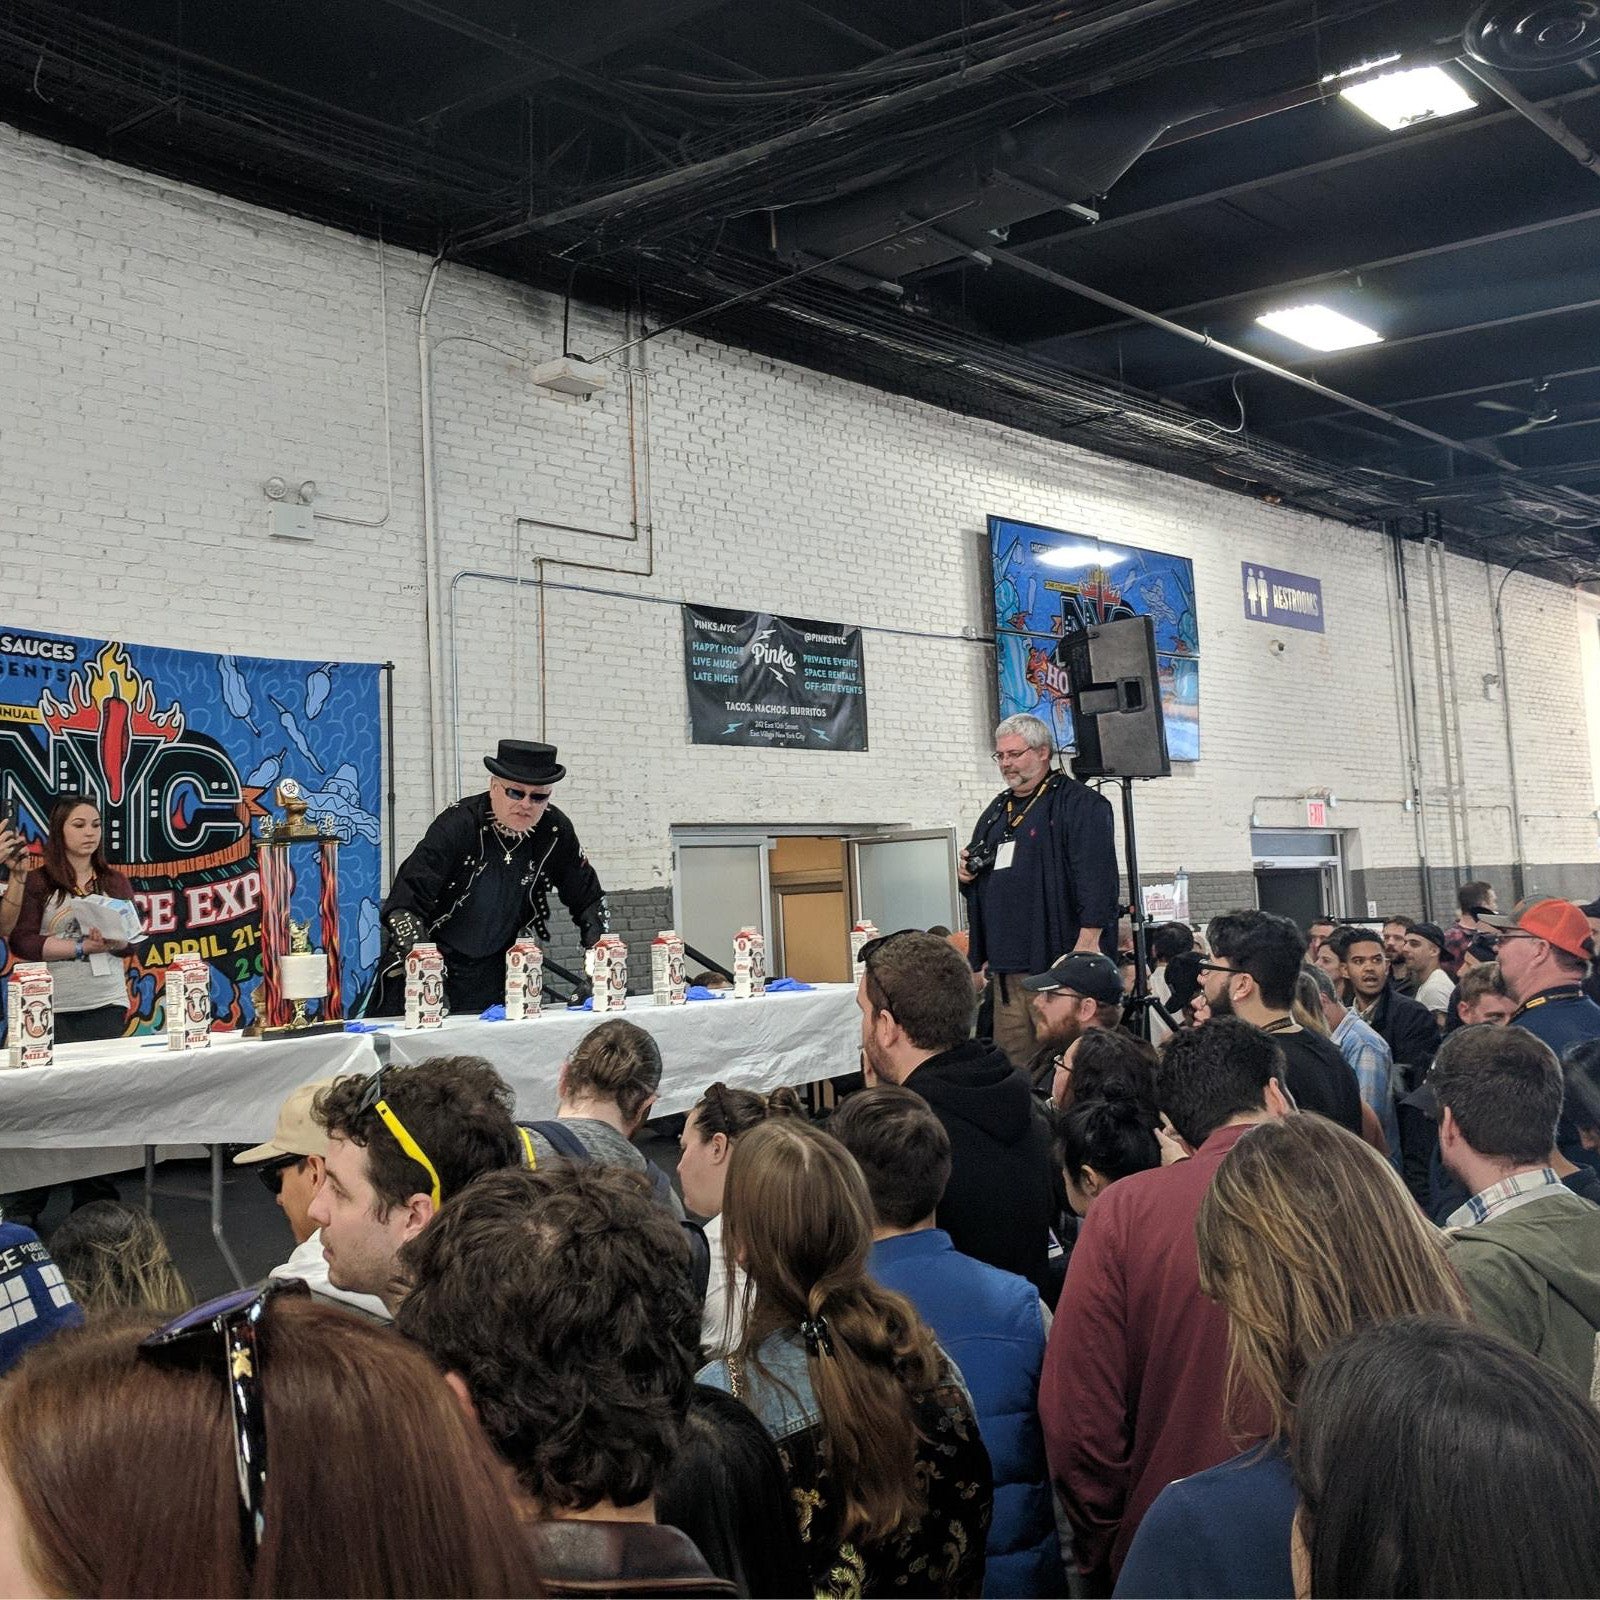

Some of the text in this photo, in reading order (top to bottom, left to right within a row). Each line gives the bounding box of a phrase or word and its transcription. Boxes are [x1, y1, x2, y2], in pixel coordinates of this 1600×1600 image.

[1273, 584, 1318, 616] RESTROOMS
[694, 620, 737, 633] PINKS.NYC
[804, 632, 847, 645] @PINKSNYC
[0, 636, 75, 661] SAUCES
[692, 641, 719, 653] HAPPY
[692, 656, 738, 669] LIVE MUSIC
[751, 642, 797, 675] Pinks
[803, 654, 858, 668] PRIVATE EVENTS
[693, 671, 739, 684] LATE NIGHT
[804, 668, 856, 681] SPACE RENTALS
[1046, 662, 1070, 695] HO
[804, 681, 863, 695] OFF-SITE EVENTS
[0, 706, 38, 720] NUAL
[790, 706, 827, 717] BURRITOS
[188, 872, 261, 928] EXP
[145, 933, 227, 968] APRIL
